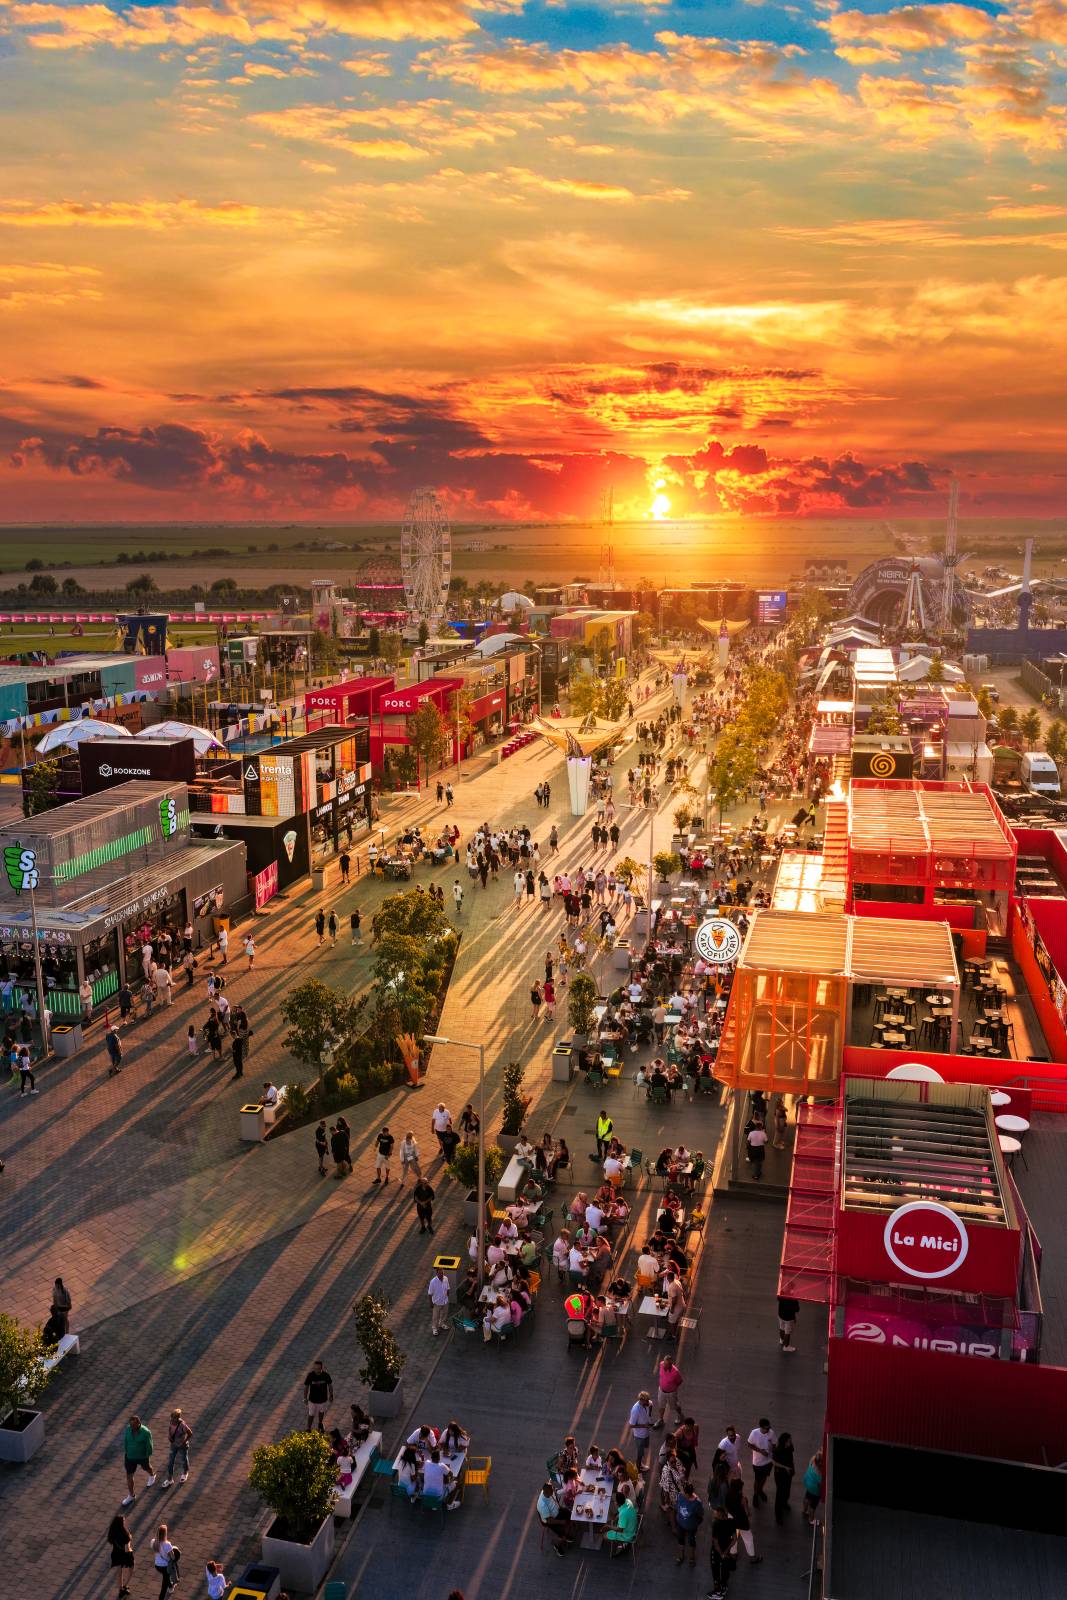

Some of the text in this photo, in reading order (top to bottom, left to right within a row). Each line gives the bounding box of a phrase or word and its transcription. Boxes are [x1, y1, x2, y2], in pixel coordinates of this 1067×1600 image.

[311, 697, 337, 706] PORC
[385, 700, 411, 709] PORC
[113, 767, 151, 776] BOOKZONE
[261, 764, 292, 775] trenta
[700, 933, 737, 959] CARTOFISSERIE
[894, 1231, 958, 1253] La Mici
